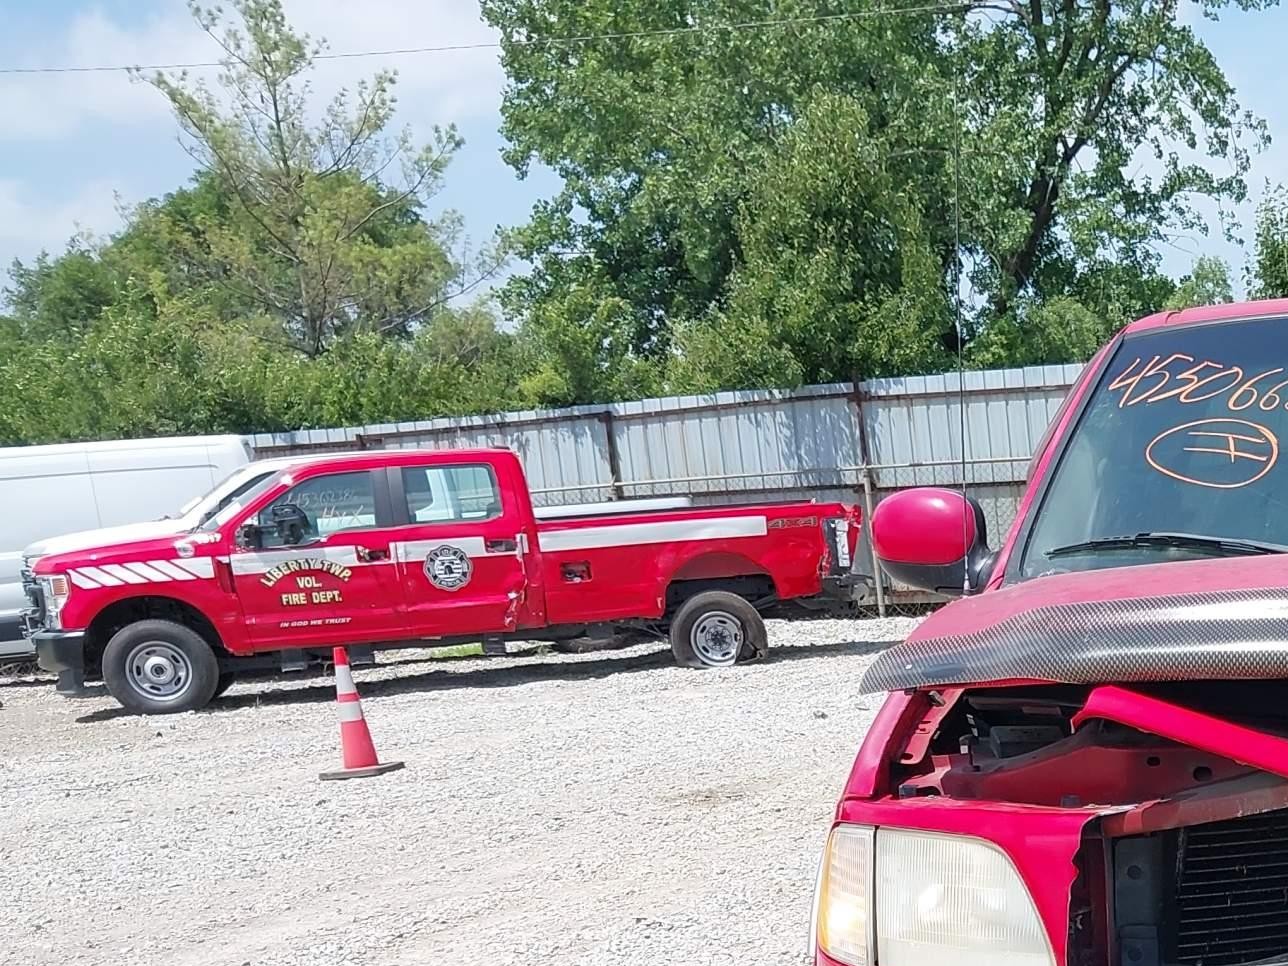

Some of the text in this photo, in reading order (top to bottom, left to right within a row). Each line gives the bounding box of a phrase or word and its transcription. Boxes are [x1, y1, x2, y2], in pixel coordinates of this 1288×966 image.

[260, 559, 352, 587] LIBERTY TWP.
[296, 576, 322, 588] VOL.
[281, 590, 342, 605] FIRE DEPT.
[325, 617, 352, 625] TRUST
